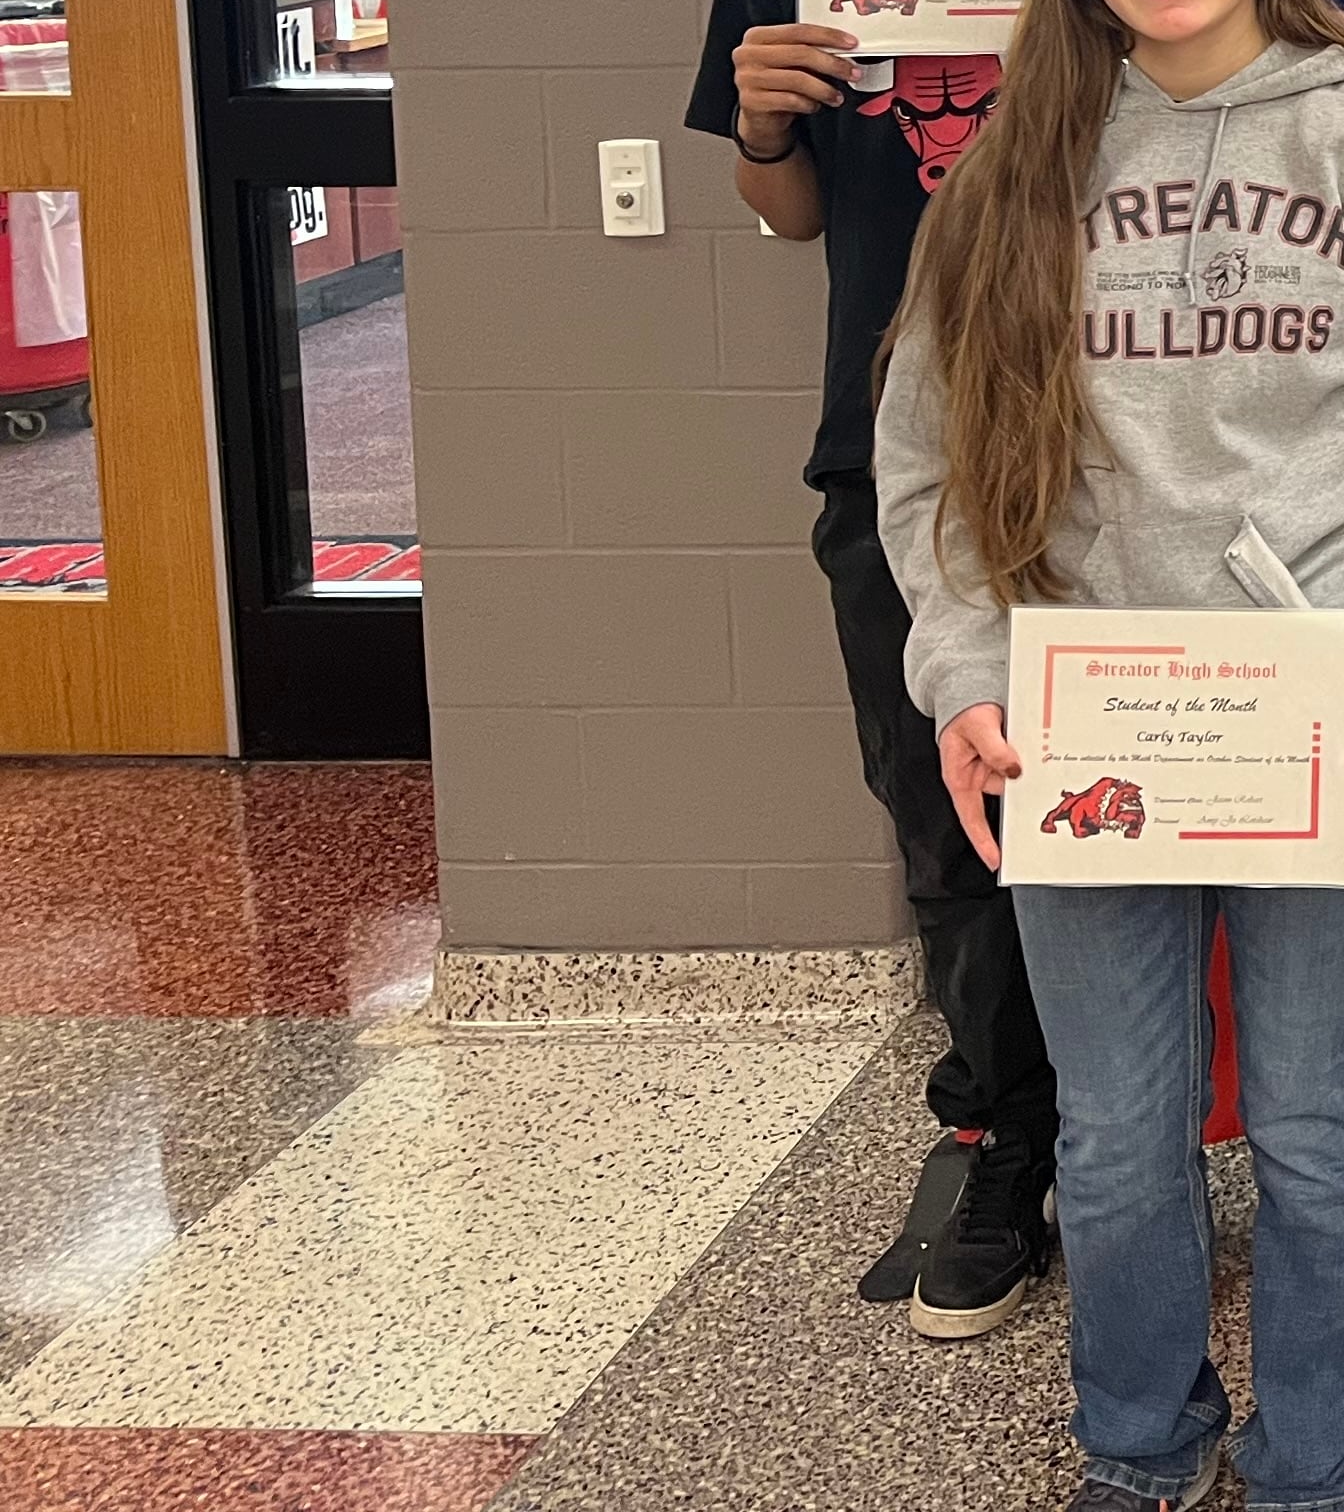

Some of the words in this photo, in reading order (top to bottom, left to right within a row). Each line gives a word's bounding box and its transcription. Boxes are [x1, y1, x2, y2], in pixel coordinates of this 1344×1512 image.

[1082, 304, 1334, 360] ULLDOGS
[1086, 661, 1160, 678] Streator
[1168, 662, 1211, 680] High
[1217, 663, 1277, 679] School
[1104, 698, 1160, 712] Student
[1165, 699, 1179, 716] of
[1186, 698, 1204, 712] the
[1210, 698, 1257, 712] Month
[1137, 731, 1173, 745] Carly
[1180, 732, 1223, 744] Taylor
